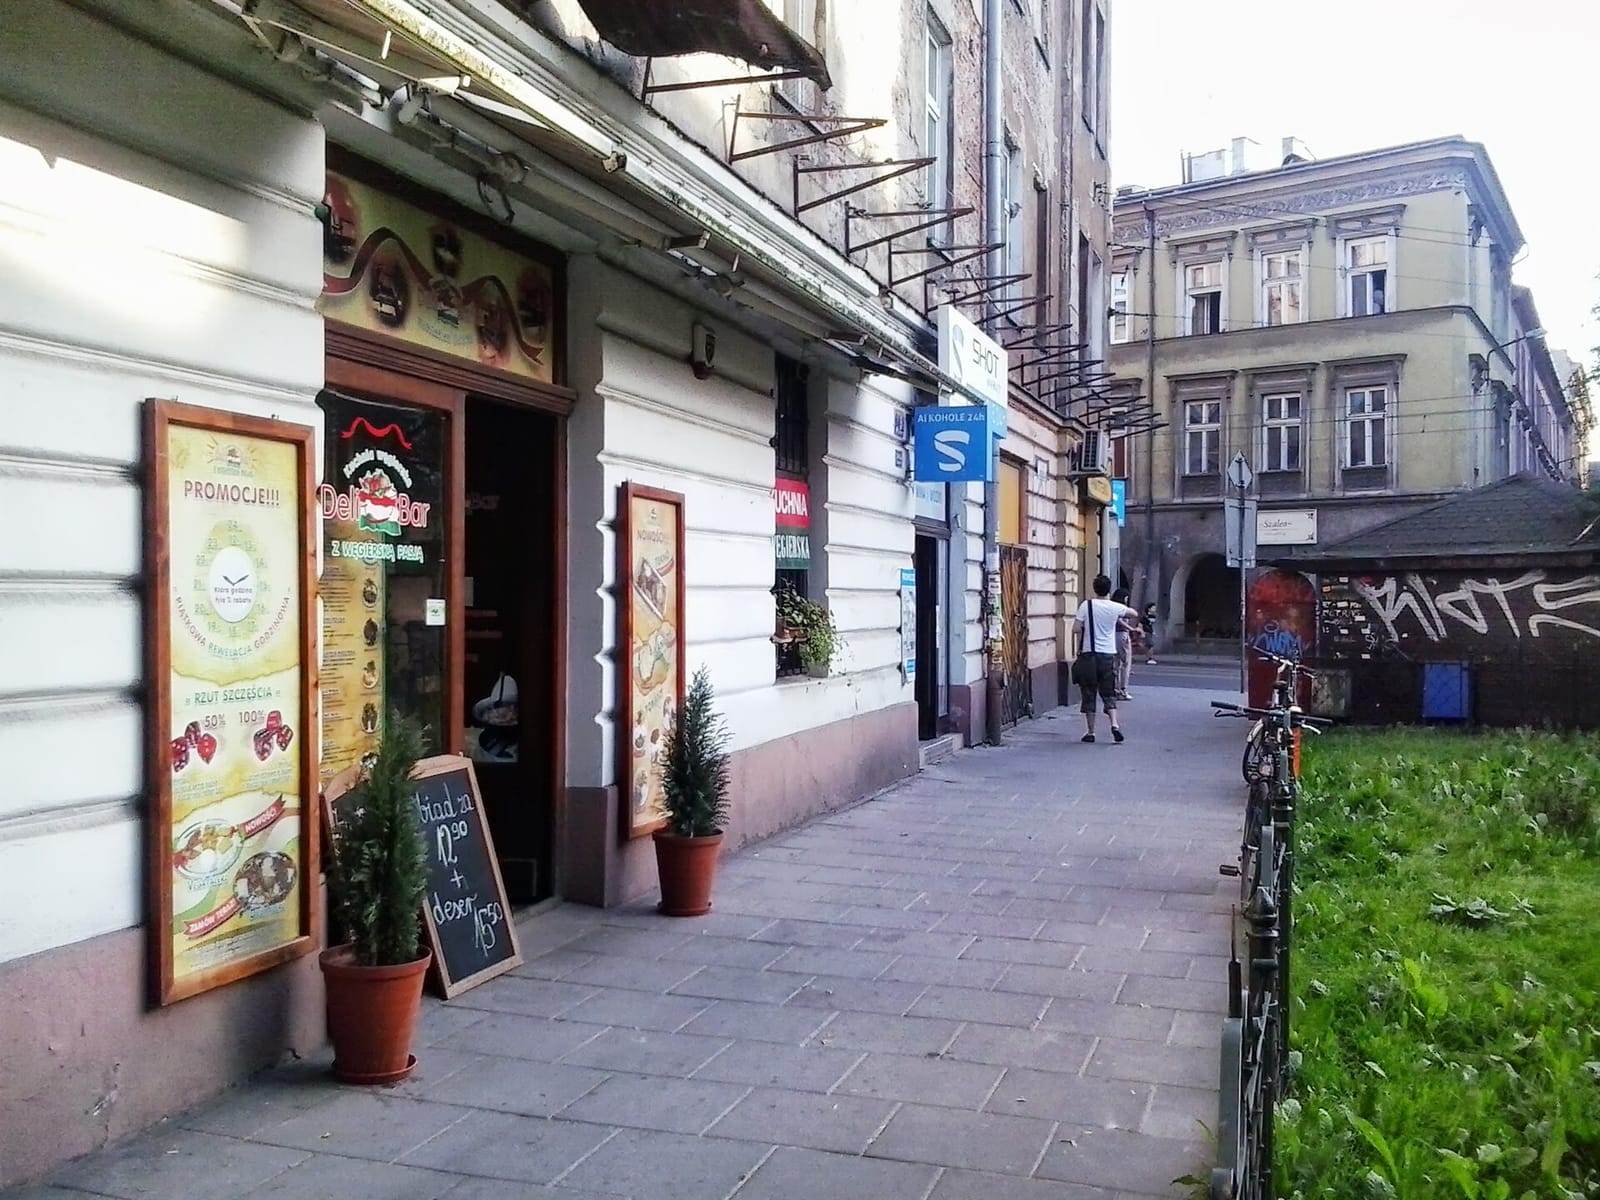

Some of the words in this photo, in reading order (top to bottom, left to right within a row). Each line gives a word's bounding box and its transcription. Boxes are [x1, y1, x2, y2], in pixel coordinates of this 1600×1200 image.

[972, 338, 999, 379] SHOT
[967, 412, 985, 422] 24h
[184, 480, 280, 507] PROMOCJE!!!
[320, 484, 361, 521] Deli
[395, 493, 430, 528] Bar
[774, 488, 808, 517] UCHNIA
[331, 540, 341, 557] Z
[194, 691, 219, 704] RZUT
[223, 684, 273, 702] SZCZĘŚCIA
[416, 781, 457, 824] biad
